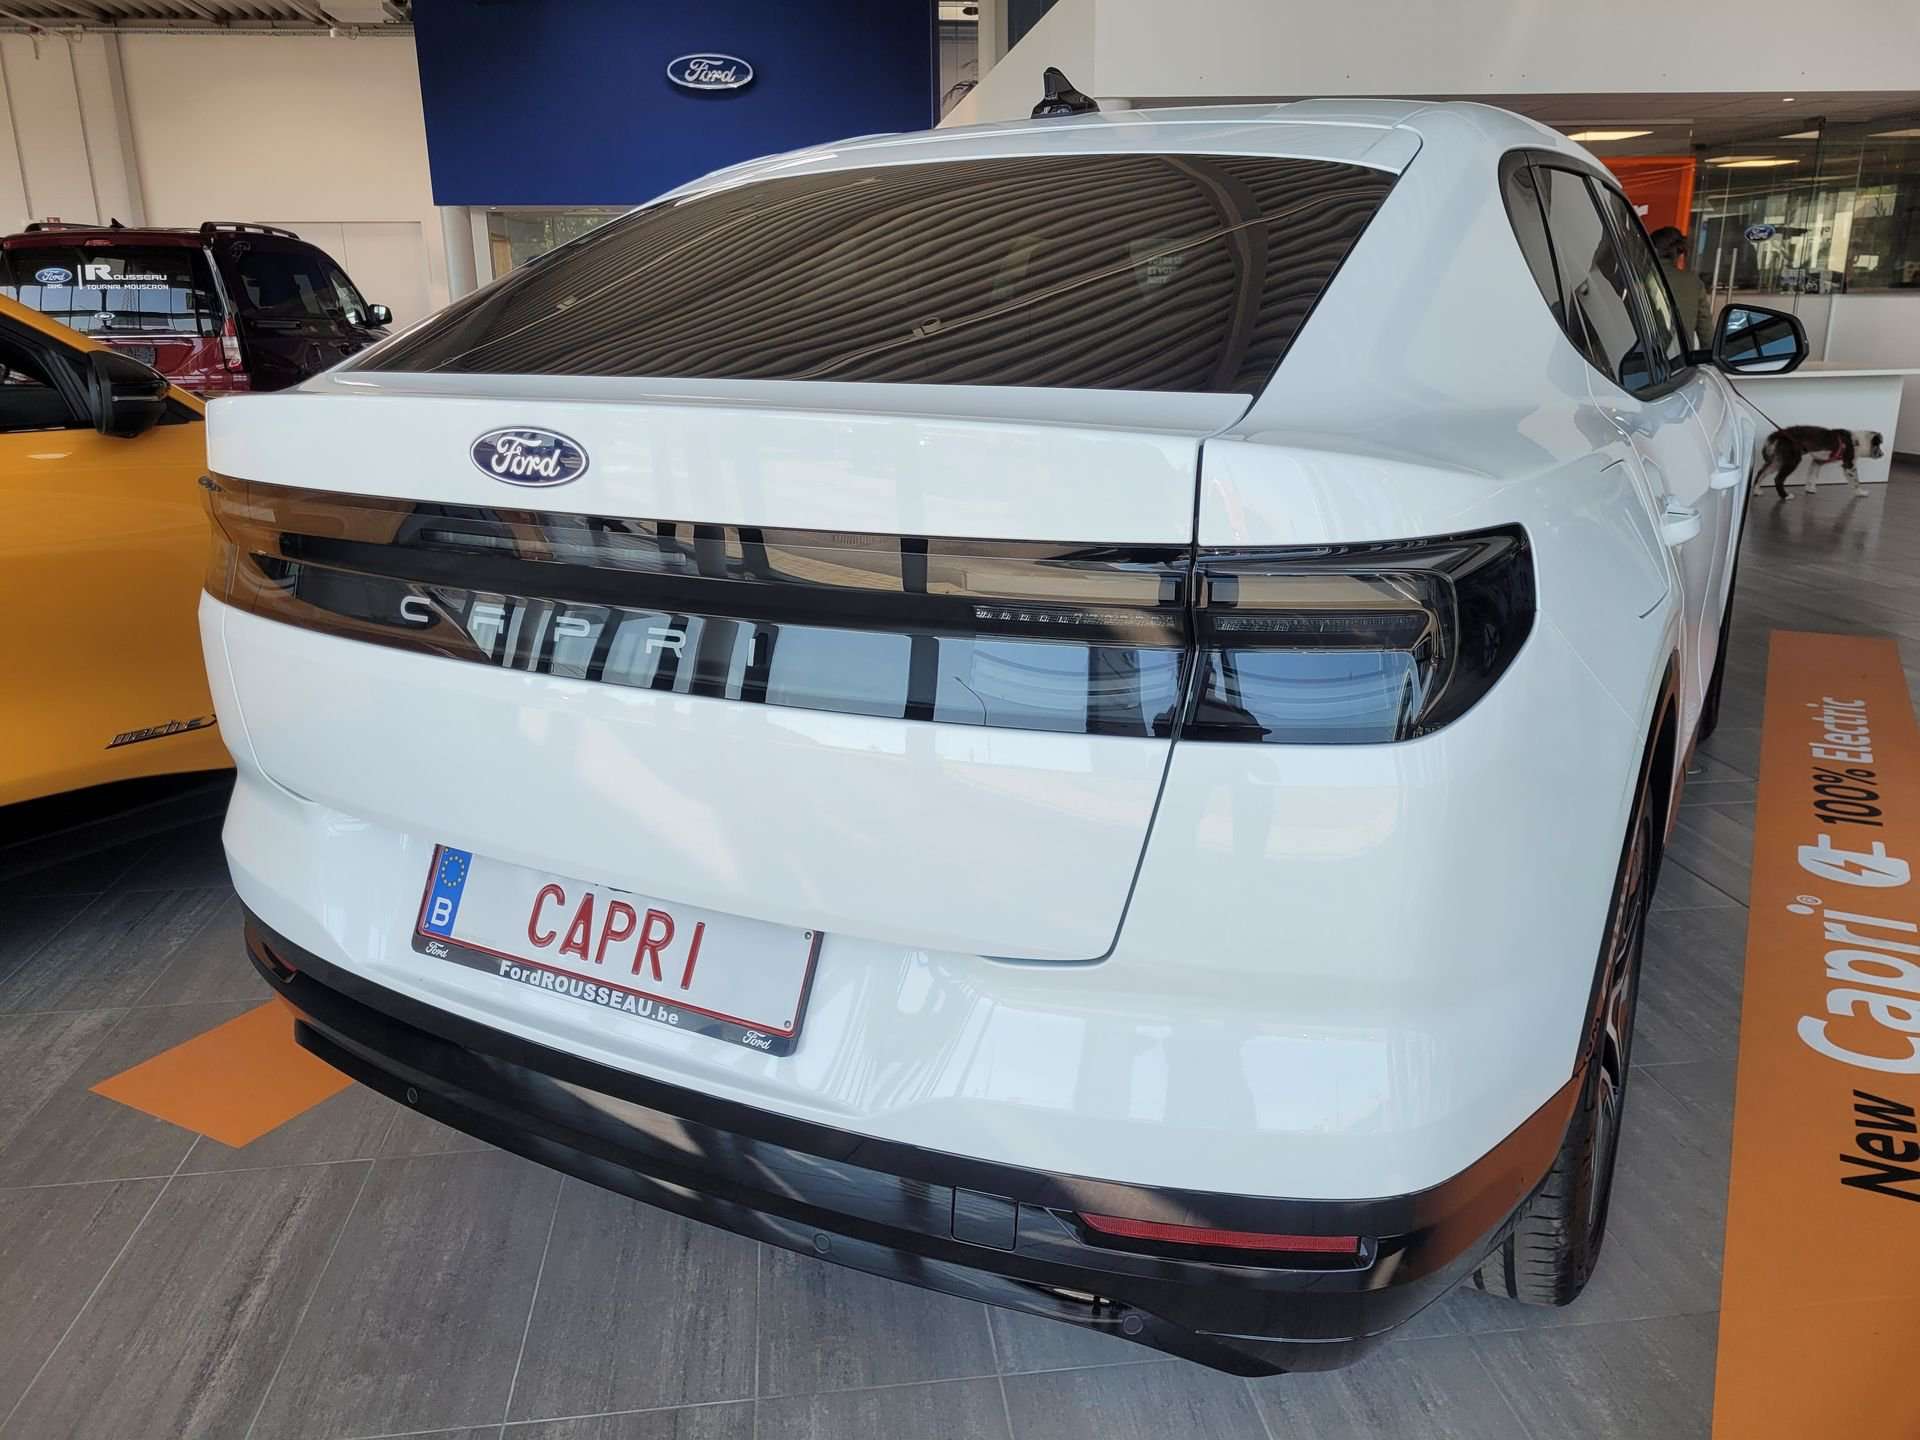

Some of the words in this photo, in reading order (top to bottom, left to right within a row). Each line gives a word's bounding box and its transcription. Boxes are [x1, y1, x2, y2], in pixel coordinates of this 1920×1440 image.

[684, 58, 737, 82] Ford
[491, 436, 561, 477] Ford
[1806, 697, 1874, 763] Electric
[1811, 766, 1884, 827] 100%
[430, 897, 453, 928] B
[527, 883, 706, 990] CAPRI
[425, 942, 449, 958] Ford
[499, 960, 679, 1025] FordROUSSEAU.be
[742, 1030, 772, 1050] Ford
[1839, 1089, 1920, 1203] New
